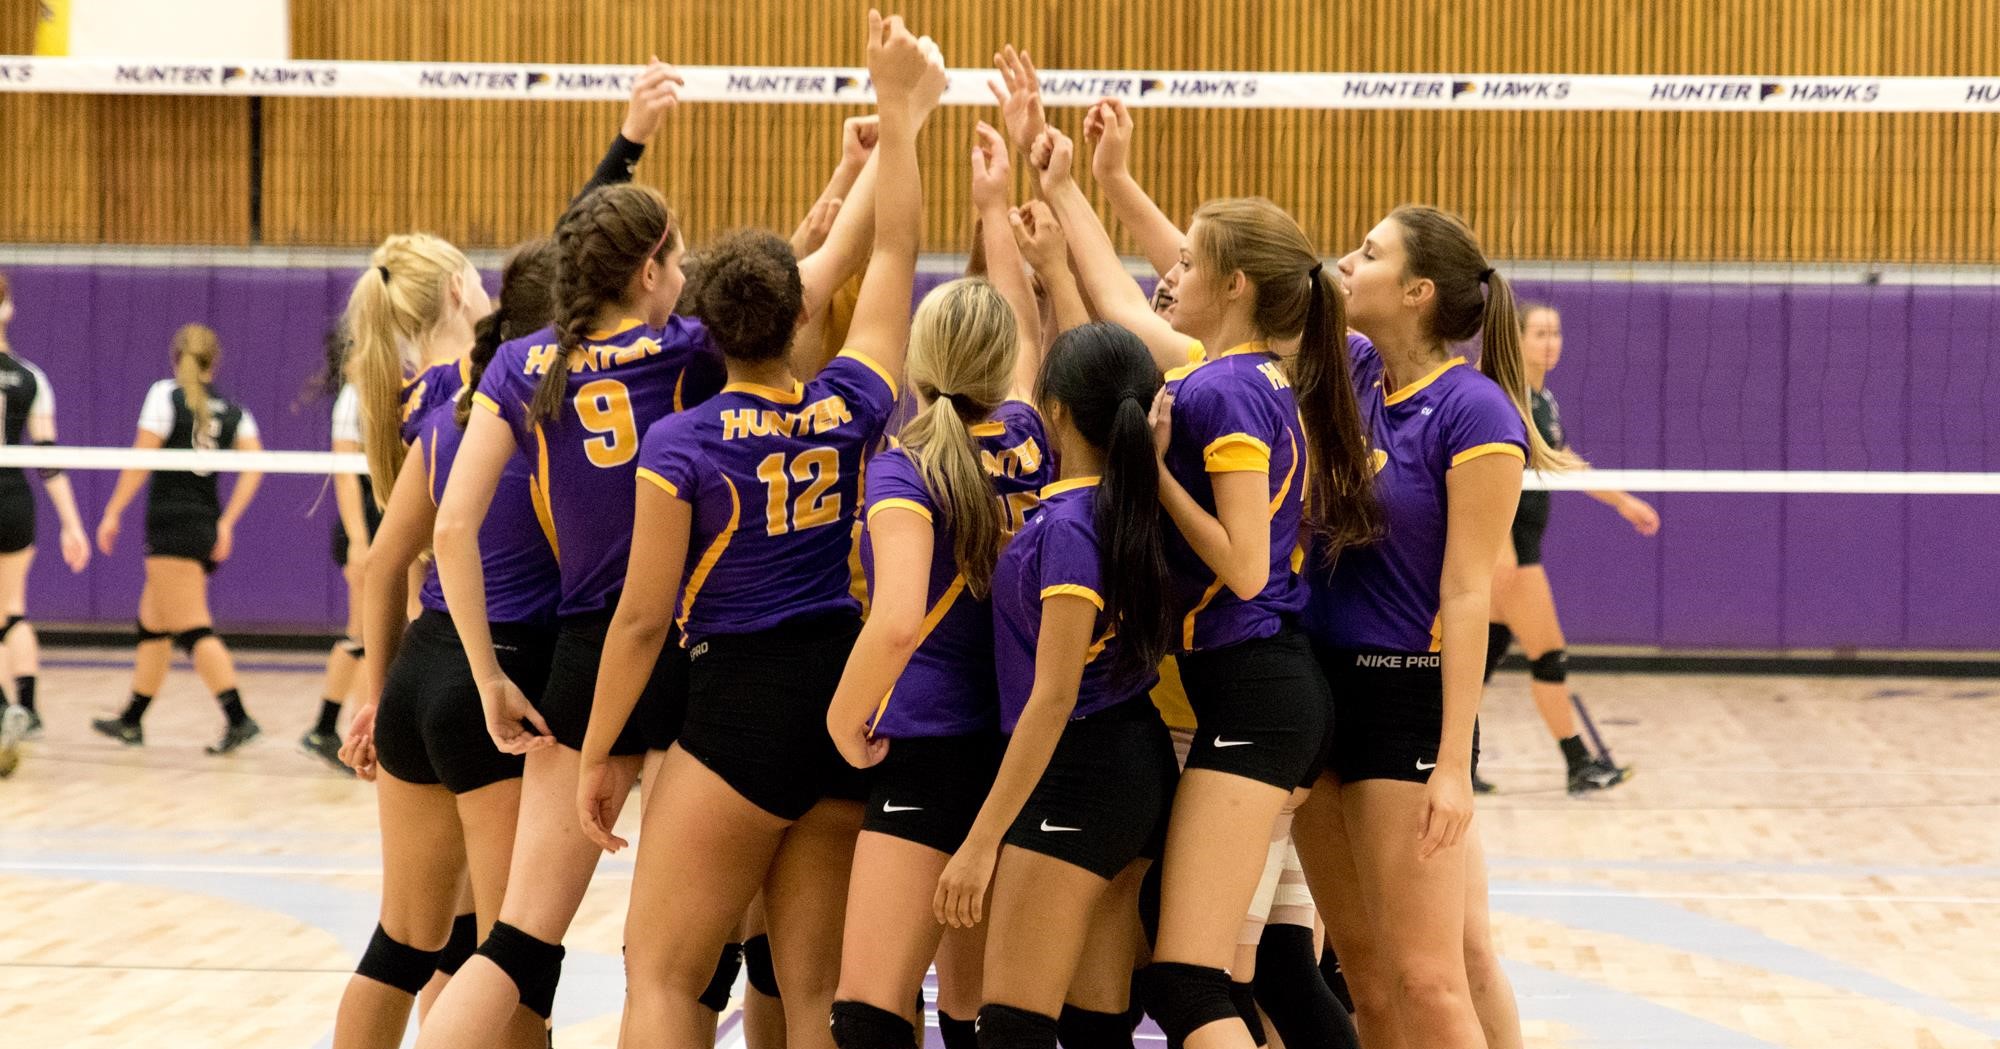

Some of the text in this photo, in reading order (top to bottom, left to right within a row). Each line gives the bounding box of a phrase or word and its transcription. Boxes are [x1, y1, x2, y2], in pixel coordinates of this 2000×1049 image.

[116, 65, 338, 86] HUNTER HAWKS
[419, 70, 518, 91] HUNTER
[727, 74, 826, 94] HUNTER
[1169, 79, 1259, 97] HAWKS
[1343, 80, 1571, 101] HUNTER HAWKS
[1651, 83, 1880, 103] HUNTER HAWKS
[523, 336, 663, 376] HNTER
[573, 378, 640, 468] 9
[720, 395, 853, 441] HUNTER
[757, 446, 842, 537] 12
[1356, 654, 1440, 668] NIKE PRO
